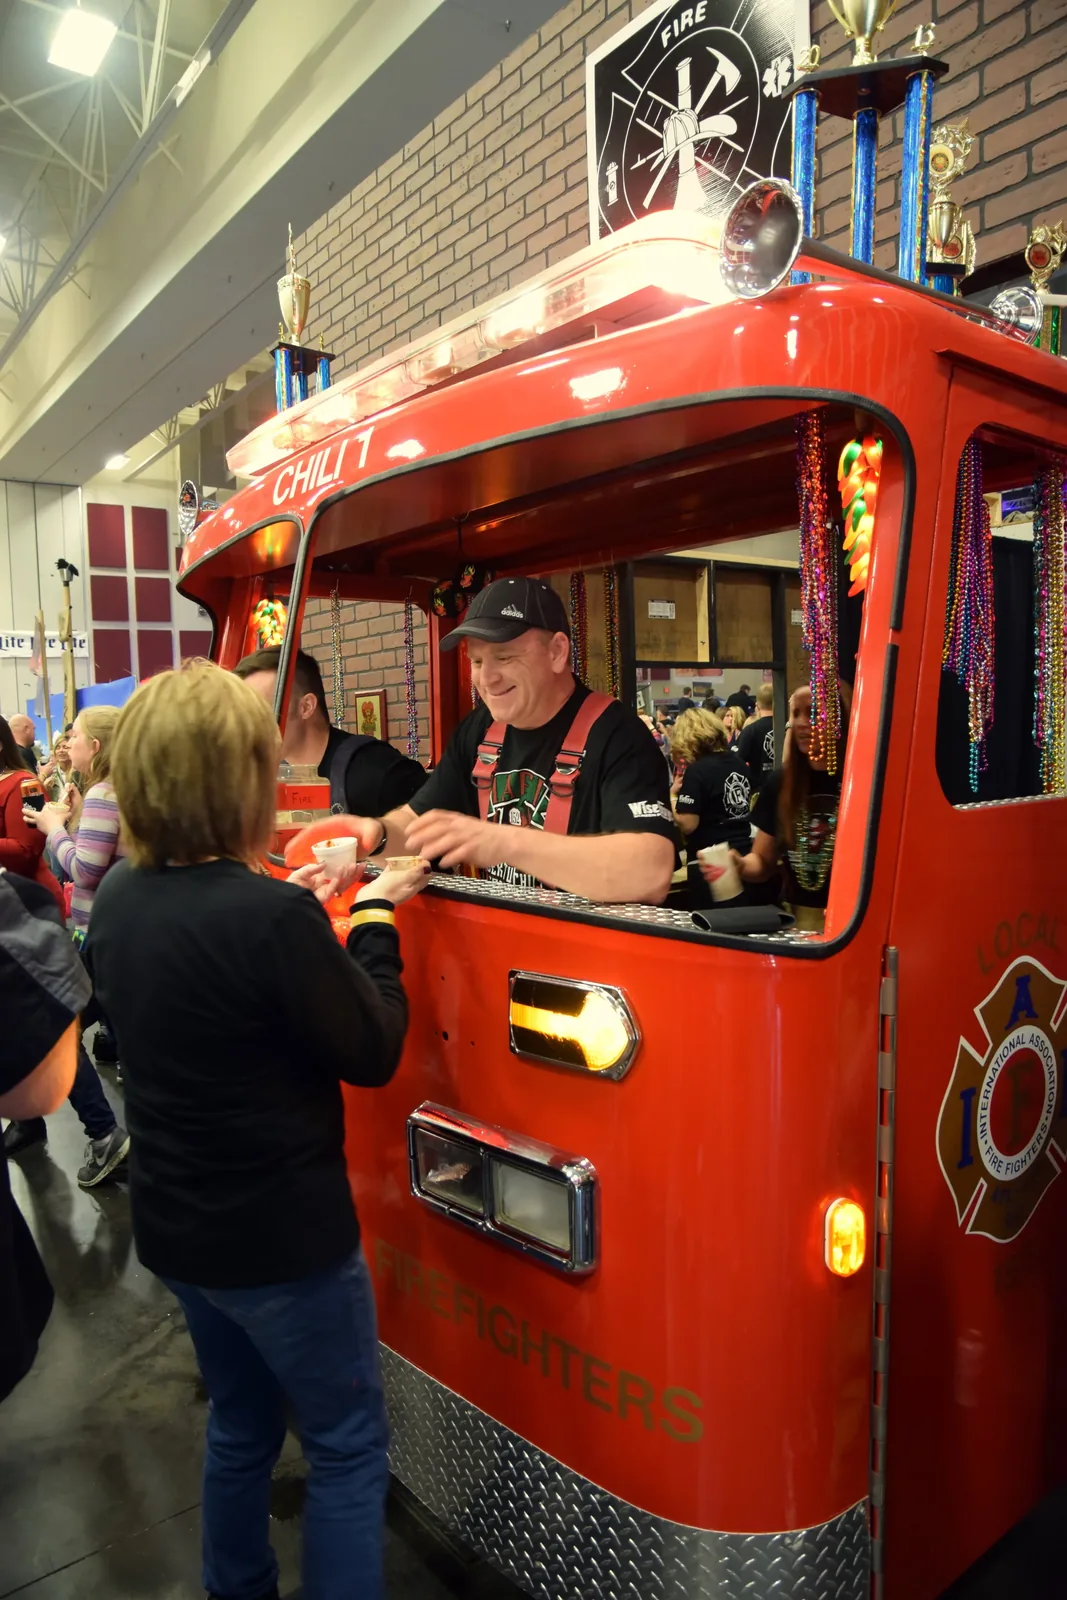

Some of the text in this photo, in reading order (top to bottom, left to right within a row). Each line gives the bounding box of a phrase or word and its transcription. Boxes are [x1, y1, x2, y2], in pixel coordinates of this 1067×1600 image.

[661, 0, 708, 48] FIRE
[272, 439, 349, 506] CHILI
[500, 609, 524, 619] adidas
[977, 911, 1059, 975] LOCAL
[1005, 974, 1039, 1031] A
[979, 1032, 1026, 1140] INTERNATIONAL
[1028, 1032, 1056, 1114] ASSOCIATION
[985, 1123, 1048, 1176] FIRE FIGHTERS
[375, 1239, 704, 1443] FIREFIGHTERS
